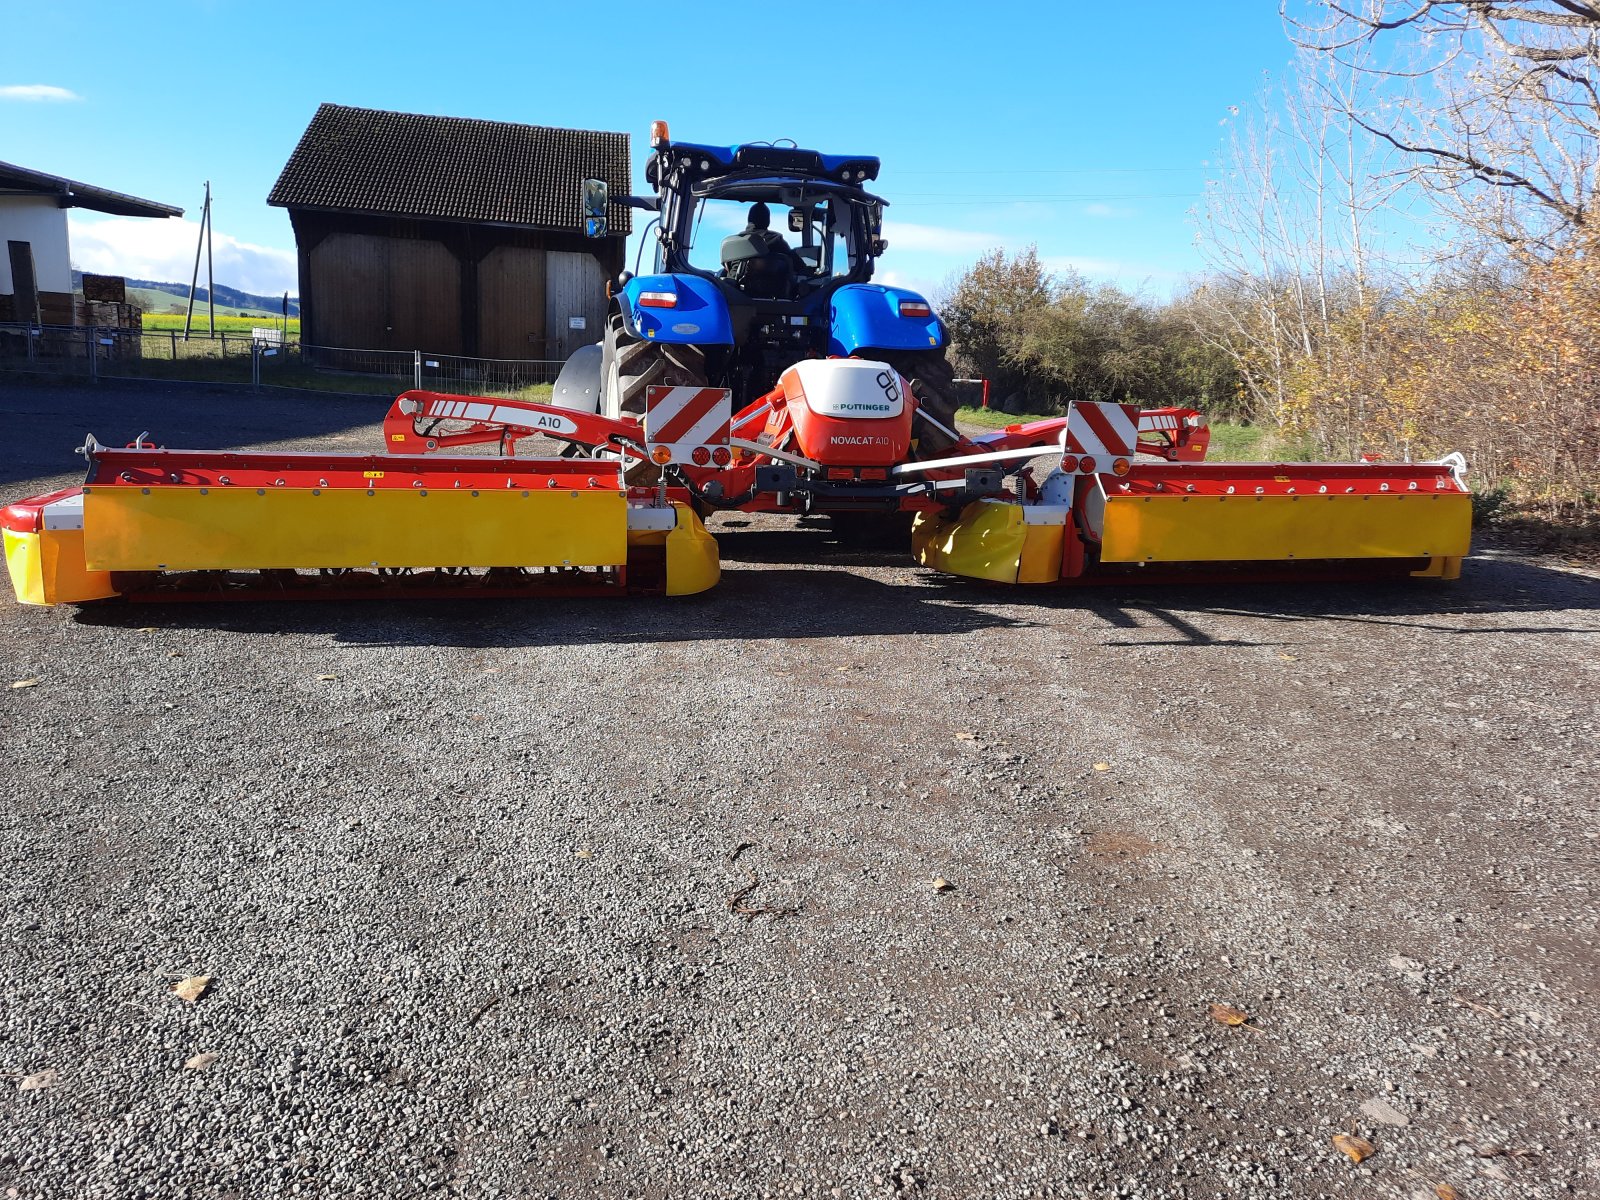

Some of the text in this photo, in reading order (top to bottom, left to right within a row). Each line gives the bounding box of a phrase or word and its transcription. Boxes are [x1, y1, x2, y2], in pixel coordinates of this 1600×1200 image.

[538, 416, 561, 428] A10
[830, 436, 890, 445] NOVACAT A10
